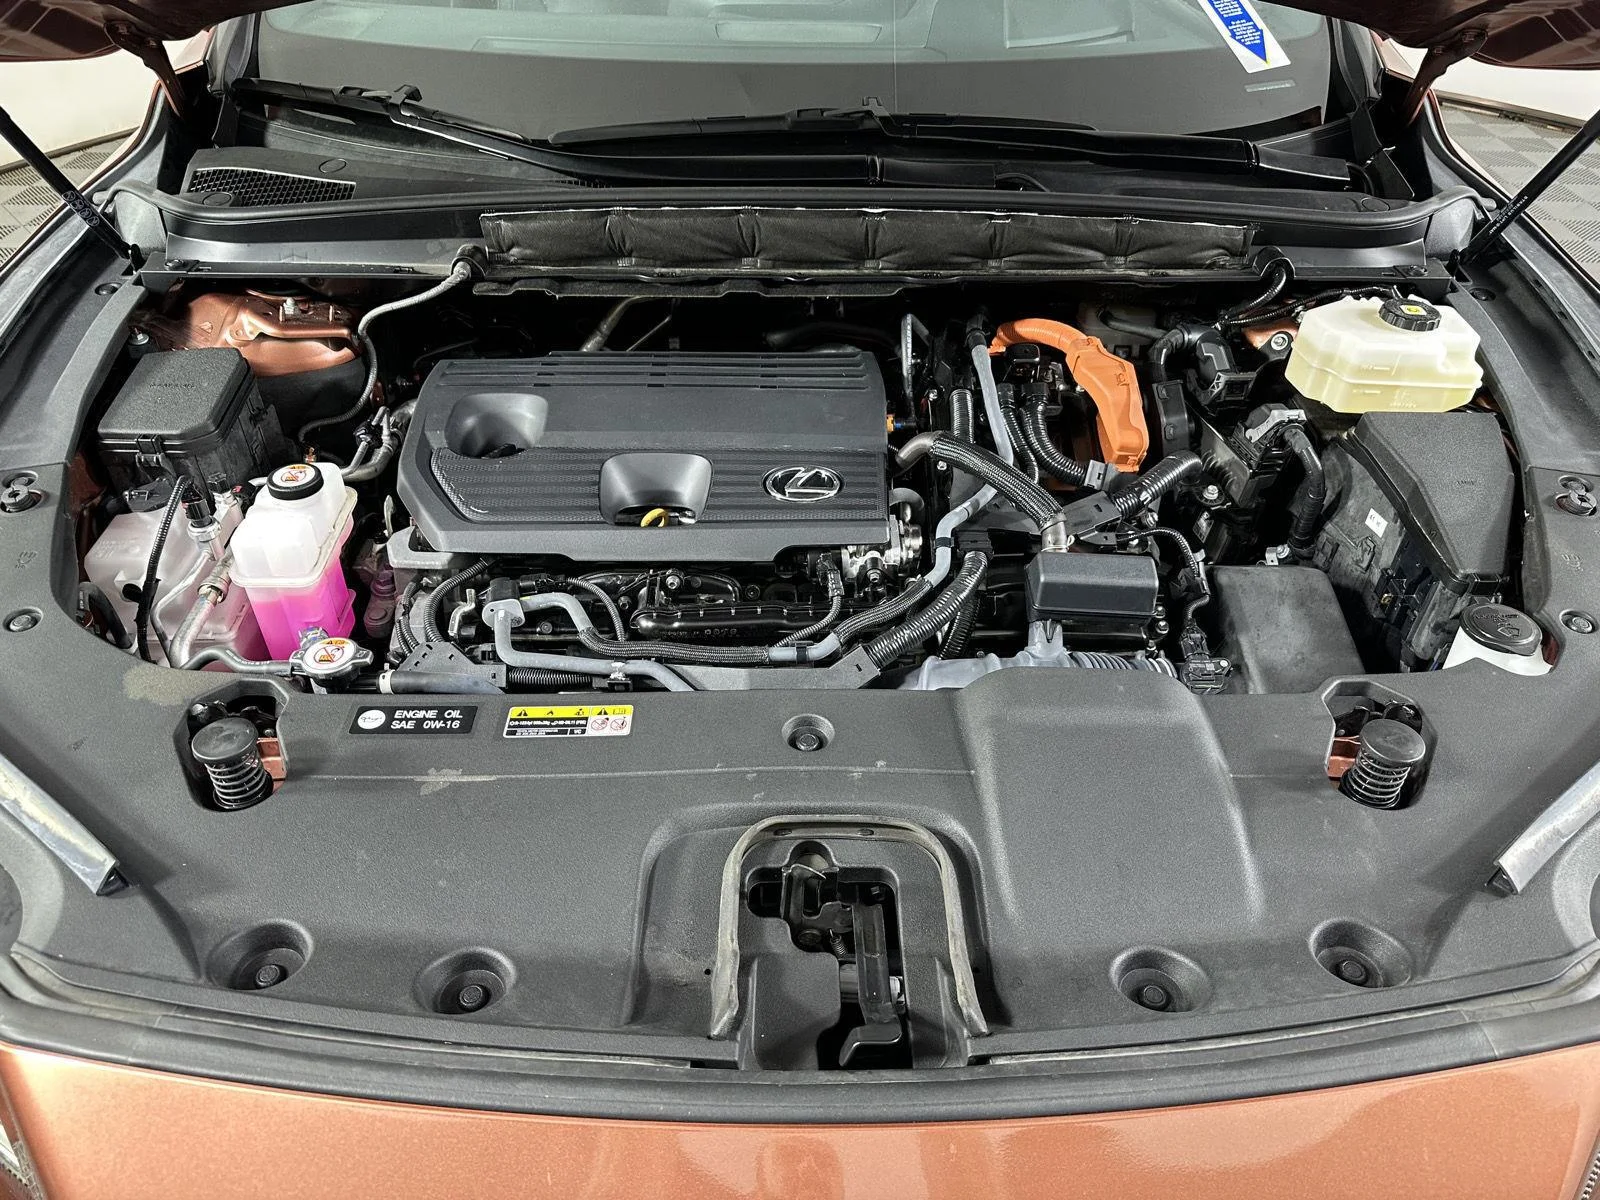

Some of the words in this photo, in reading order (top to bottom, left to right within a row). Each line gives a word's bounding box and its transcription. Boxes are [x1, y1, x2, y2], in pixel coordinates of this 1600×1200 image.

[394, 709, 438, 719] ENGINE
[444, 709, 463, 719] OIL
[390, 720, 416, 729] SAE
[423, 720, 460, 729] 0W-16
